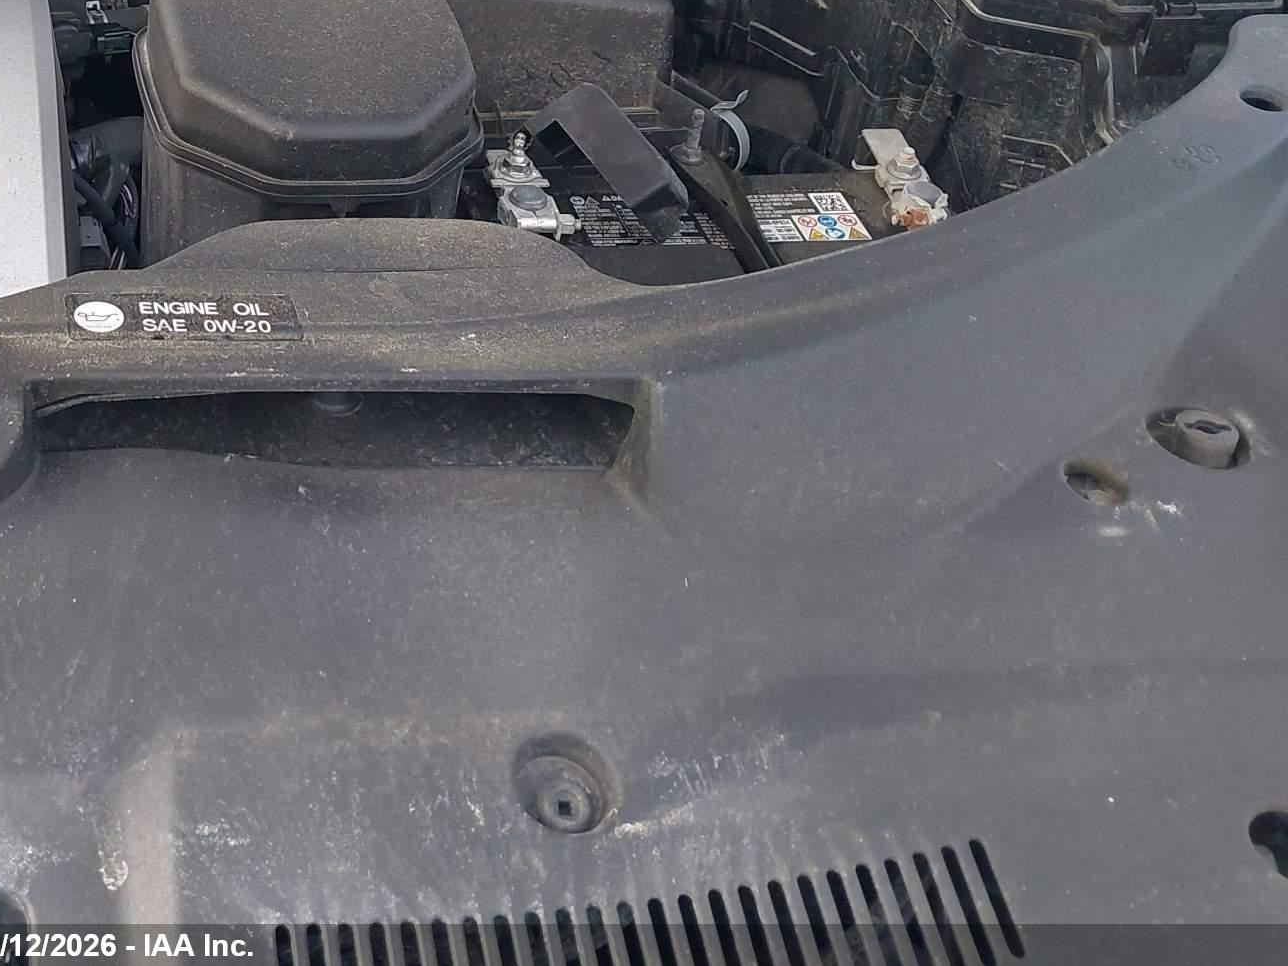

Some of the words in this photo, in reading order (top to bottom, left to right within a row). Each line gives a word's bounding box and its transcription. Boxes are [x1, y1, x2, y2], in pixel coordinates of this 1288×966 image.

[139, 302, 219, 315] ENGINE
[233, 303, 270, 316] OIL
[143, 319, 187, 332] SAE
[204, 320, 272, 333] 0W-20
